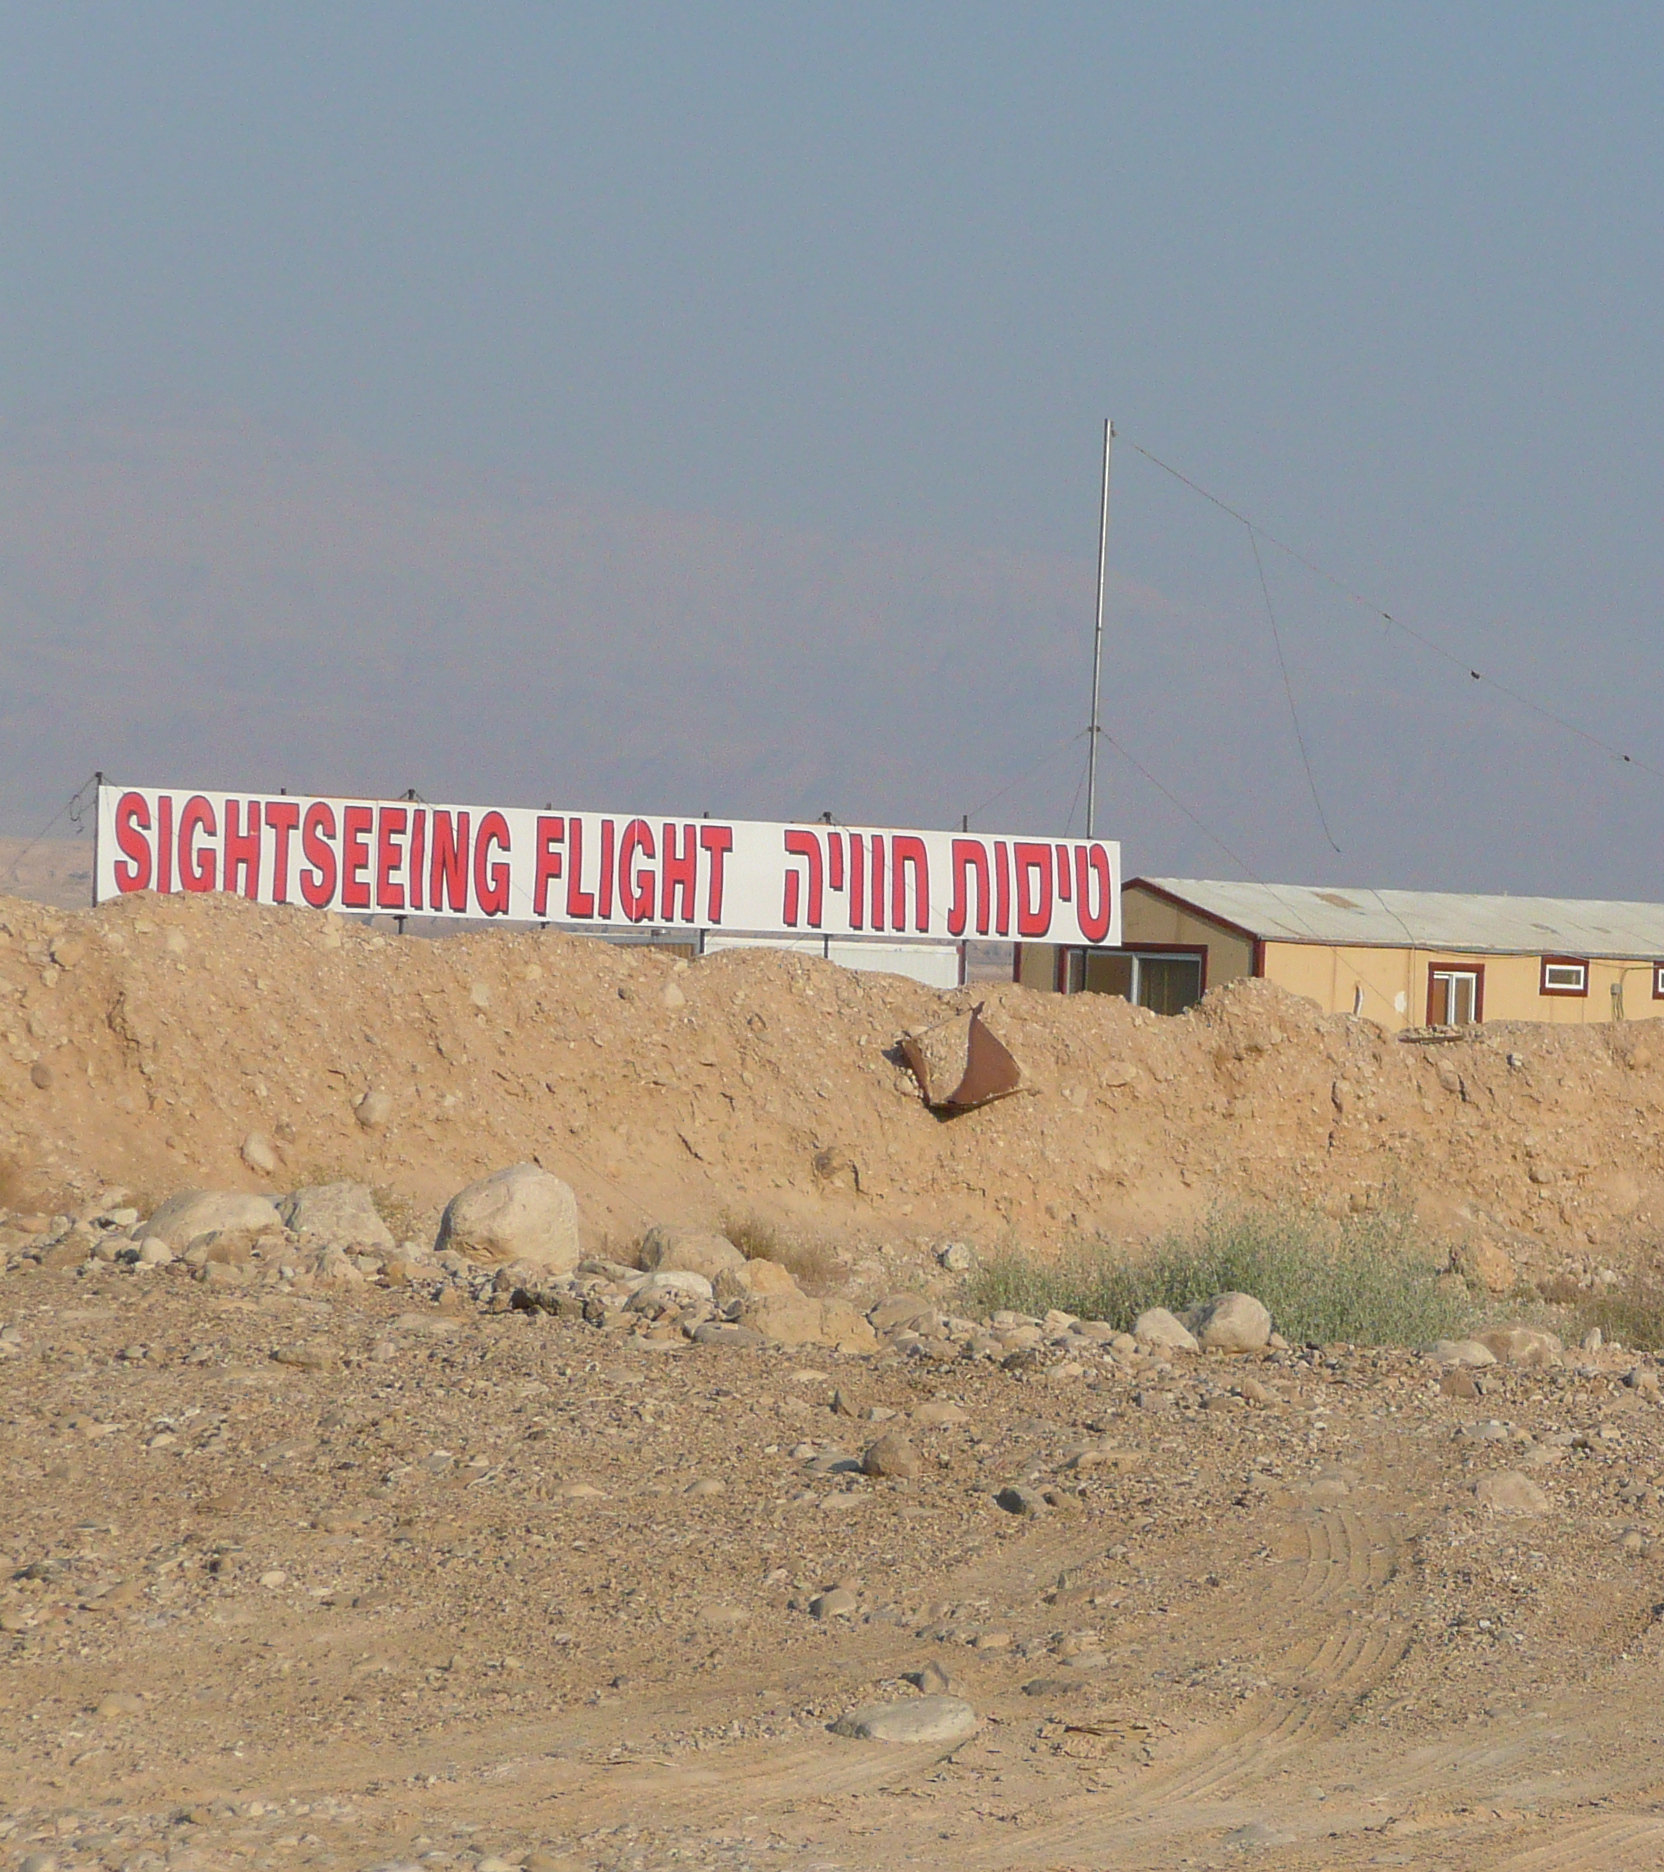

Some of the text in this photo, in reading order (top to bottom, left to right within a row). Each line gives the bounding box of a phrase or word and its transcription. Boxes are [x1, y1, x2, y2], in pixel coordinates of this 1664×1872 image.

[113, 791, 734, 925] SIGHTSEEING FLIGHT
[782, 829, 1111, 944] טיסות חוויה
